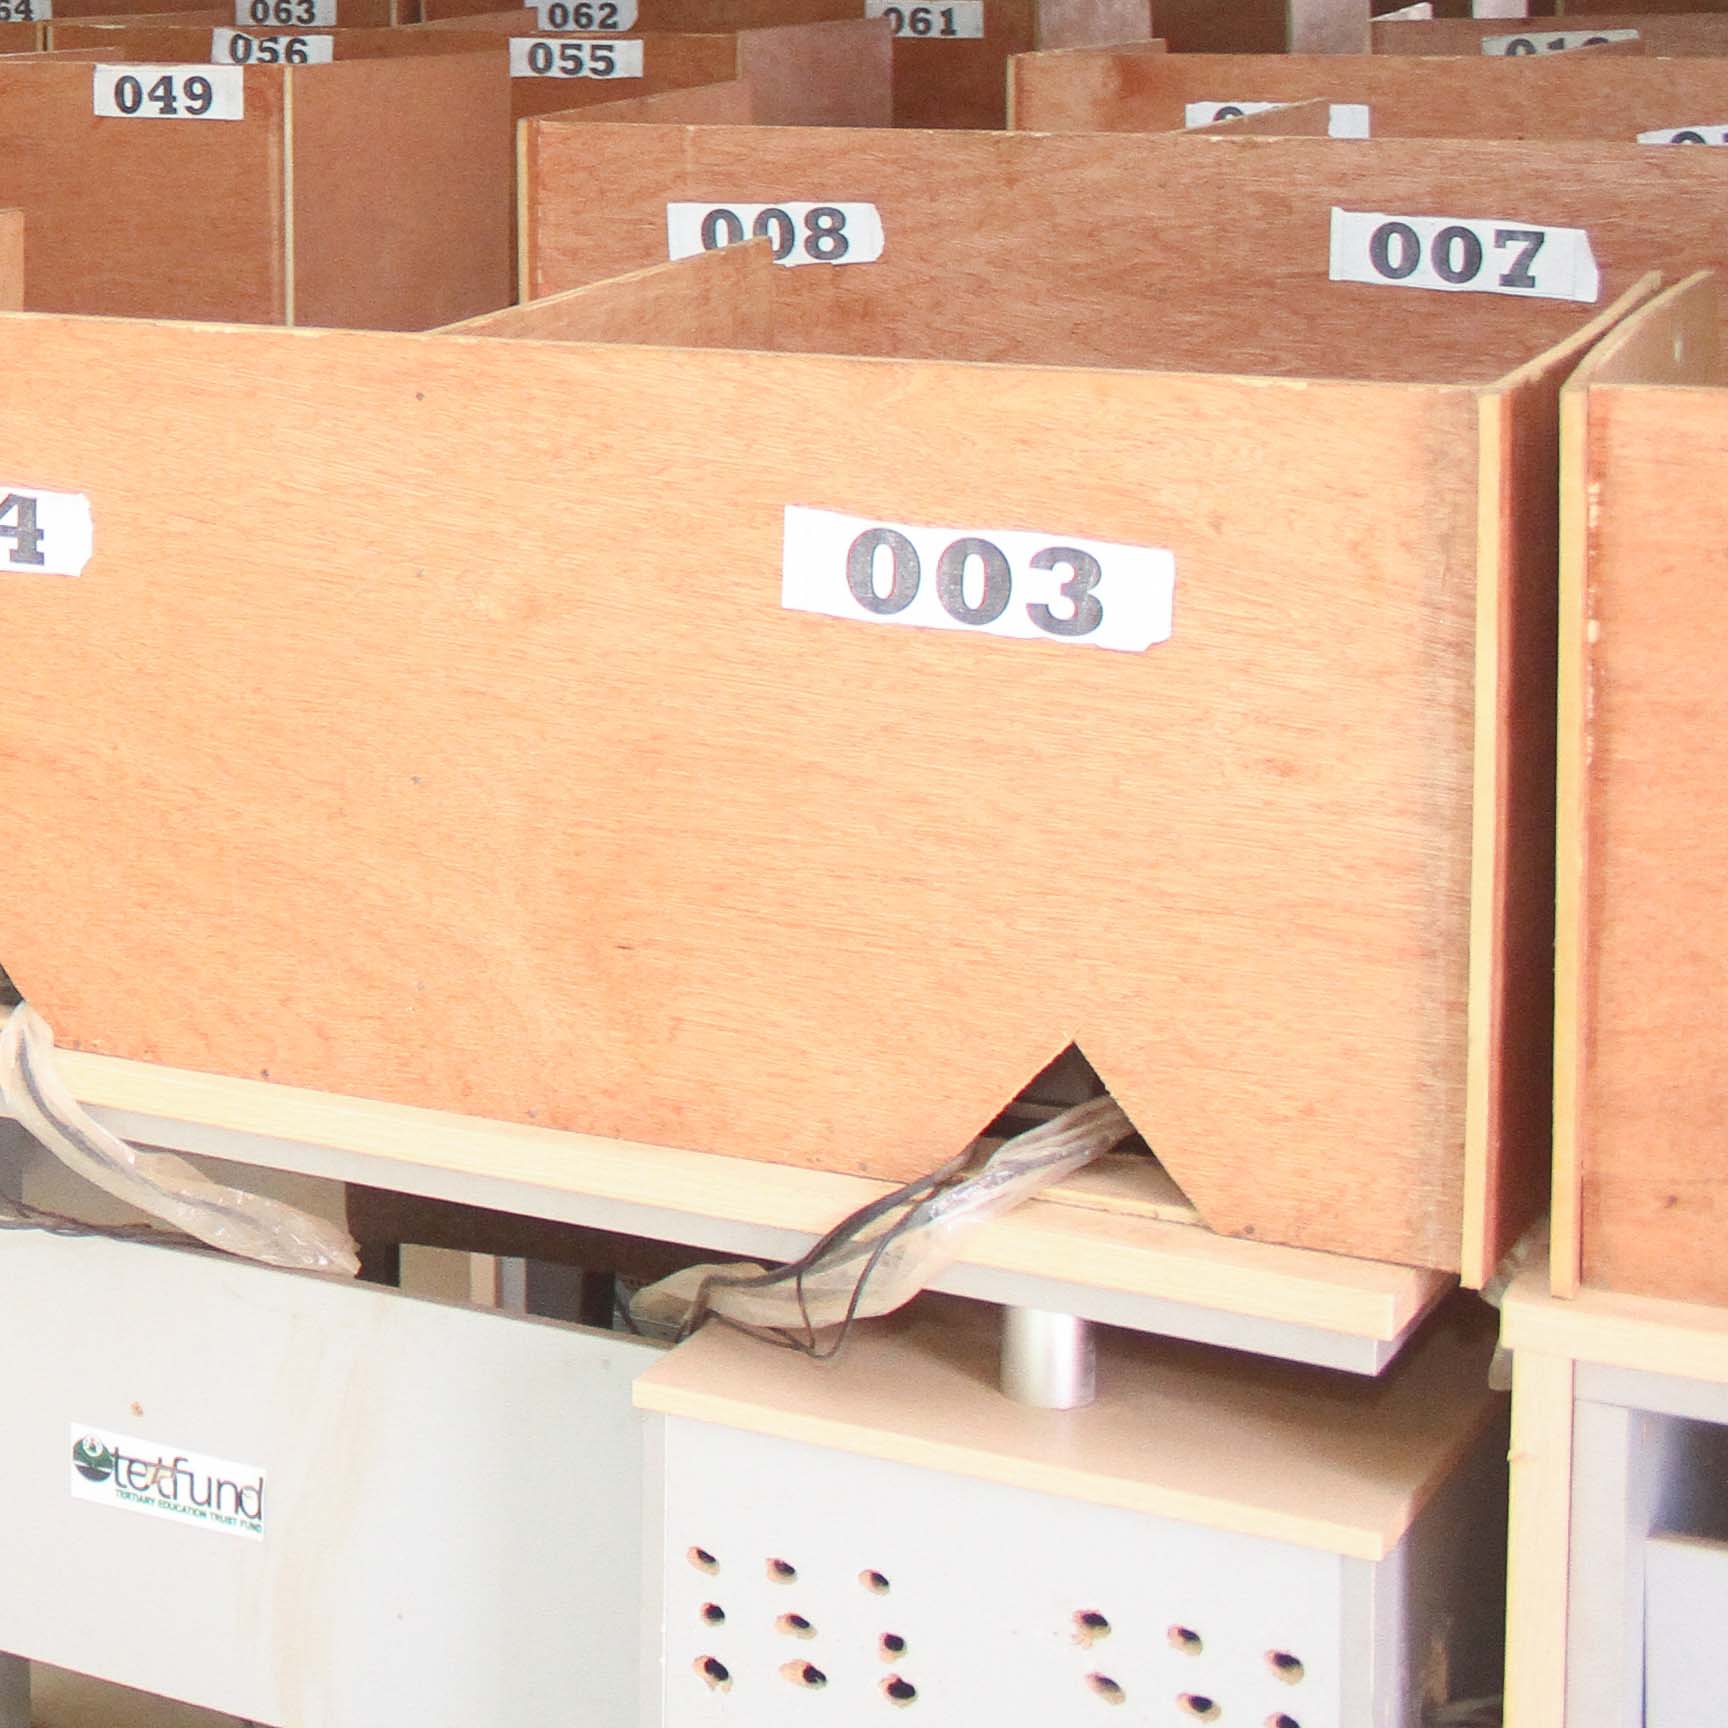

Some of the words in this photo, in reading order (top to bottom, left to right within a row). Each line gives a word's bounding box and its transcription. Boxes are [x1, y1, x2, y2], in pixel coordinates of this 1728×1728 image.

[548, 2, 619, 30] 062
[229, 33, 309, 64] 056
[527, 42, 616, 76] 055
[114, 74, 214, 116] 049
[1368, 221, 1546, 288] 007
[845, 526, 1105, 637] 003
[111, 1446, 264, 1521] tetfund
